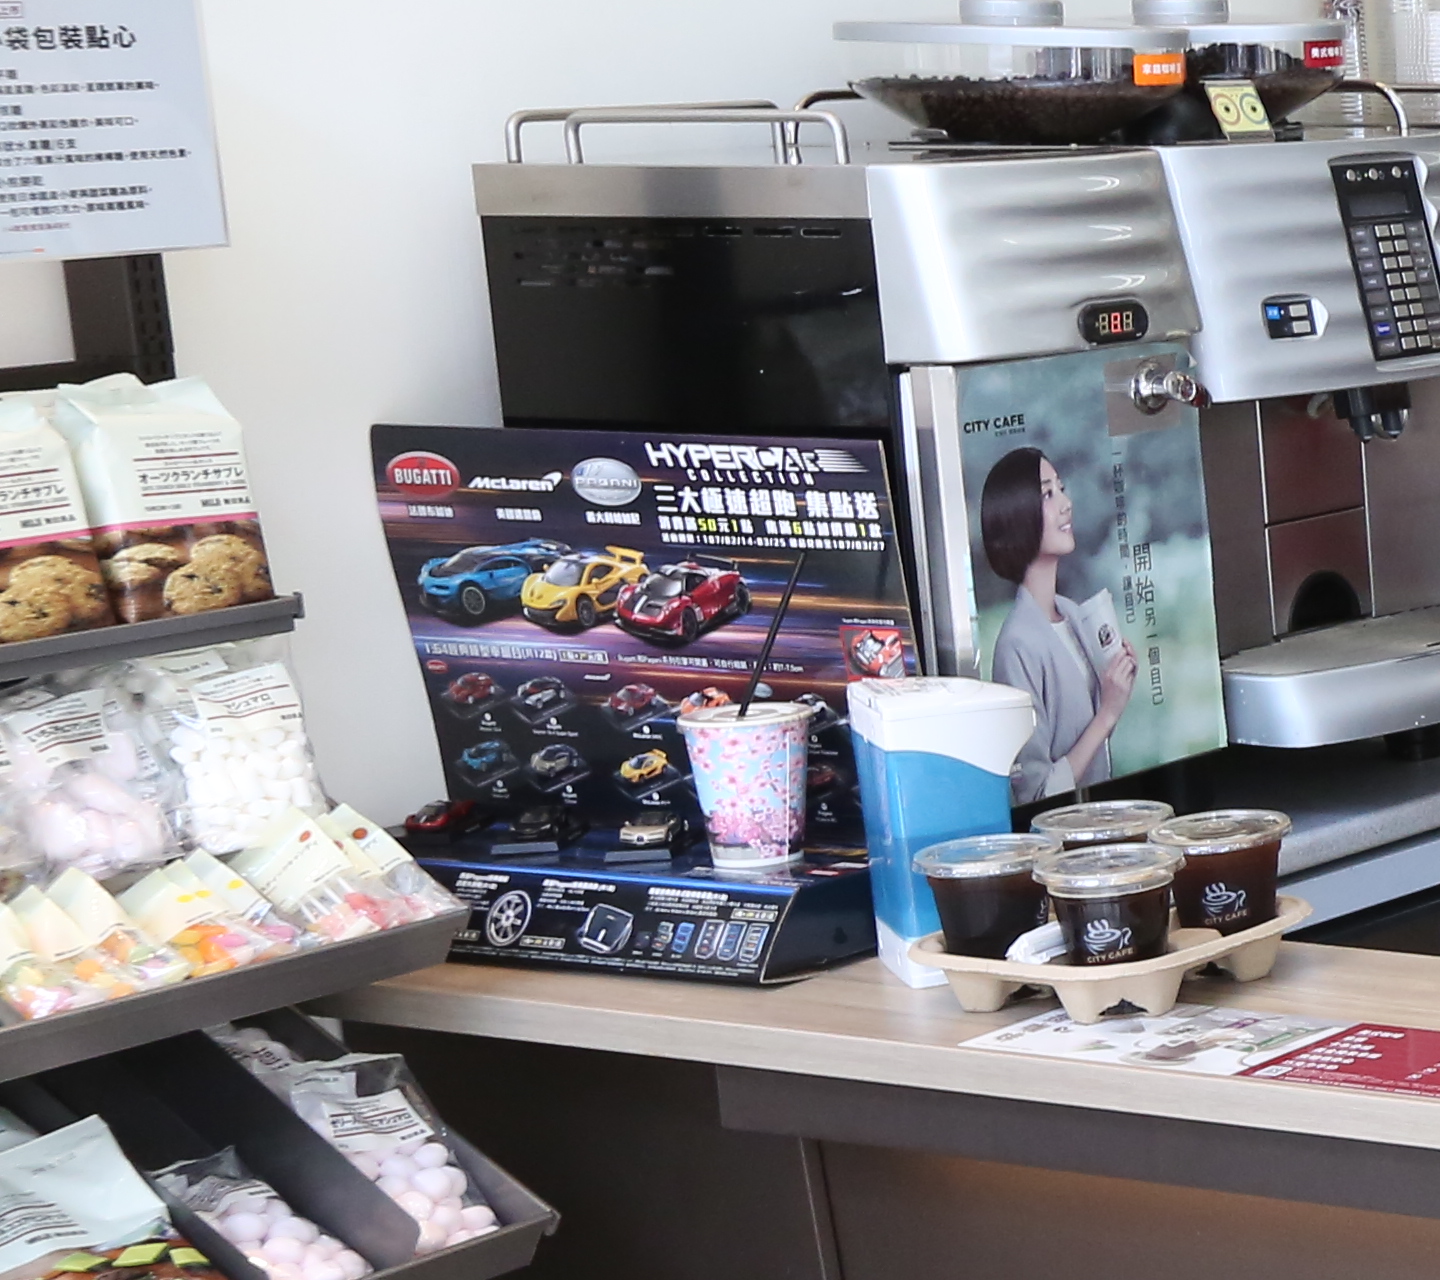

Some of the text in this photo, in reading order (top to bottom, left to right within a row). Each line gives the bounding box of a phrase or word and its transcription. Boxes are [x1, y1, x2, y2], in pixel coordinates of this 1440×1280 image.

[0, 25, 136, 50] 袋包裝點心
[963, 420, 991, 434] CITY
[993, 414, 1026, 428] CAFE
[394, 468, 452, 486] BUGATTI
[575, 477, 639, 488] PAGANI
[686, 469, 815, 485] COLLECTION
[653, 485, 880, 519] 三大極速超跑 集點送
[1133, 541, 1165, 706] 開始另一個自己
[1204, 909, 1248, 926] CITY CAFE
[1086, 947, 1135, 965] CITY CAFE
